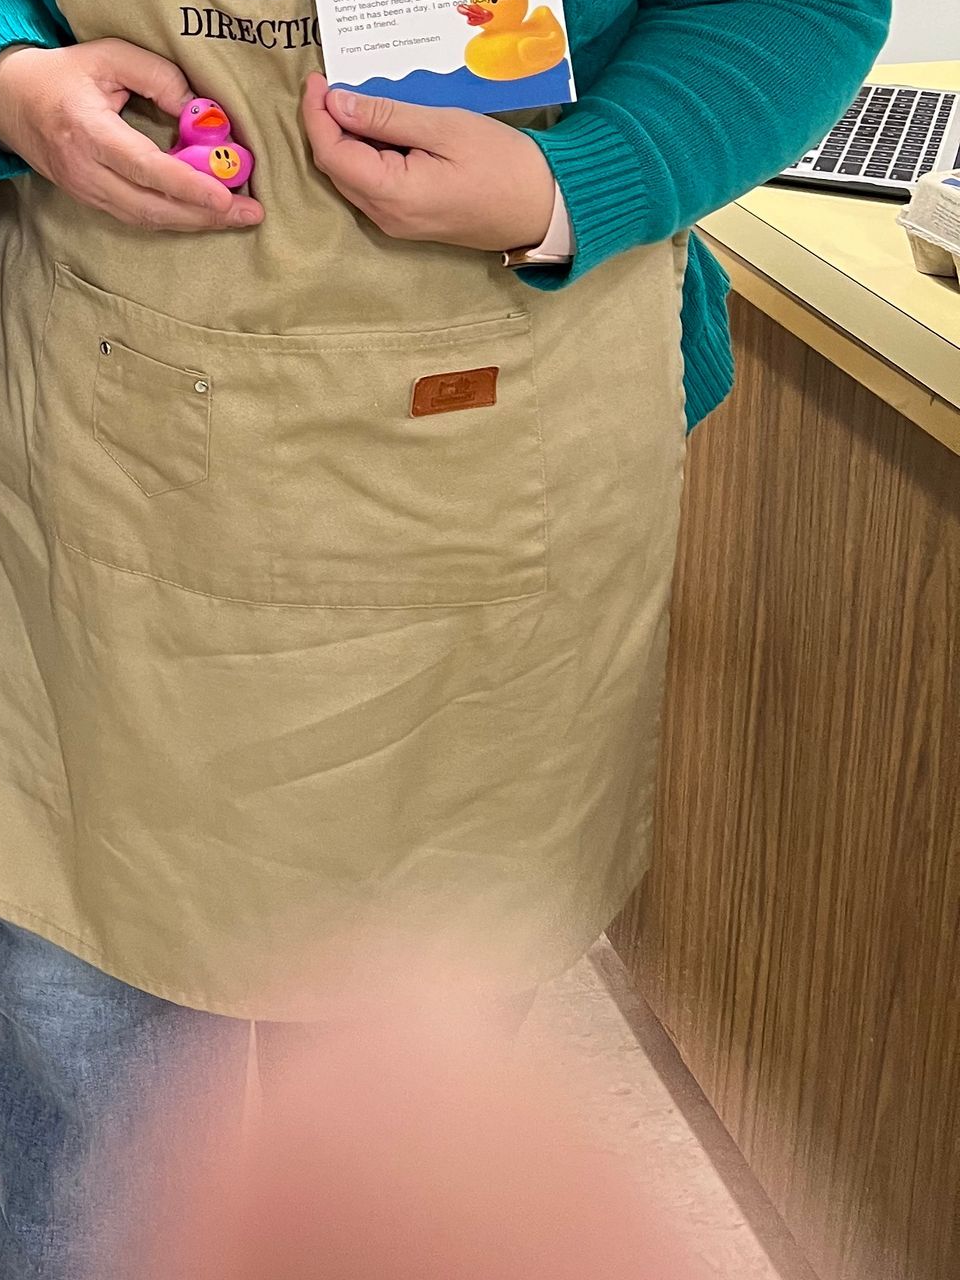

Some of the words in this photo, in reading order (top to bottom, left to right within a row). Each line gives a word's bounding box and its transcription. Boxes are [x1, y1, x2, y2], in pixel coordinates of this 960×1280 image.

[335, 5, 357, 13] funny
[358, 0, 389, 9] teacher
[336, 15, 358, 23] when
[338, 27, 353, 35] you
[363, 43, 391, 51] Carlee
[392, 36, 441, 47] Christensen
